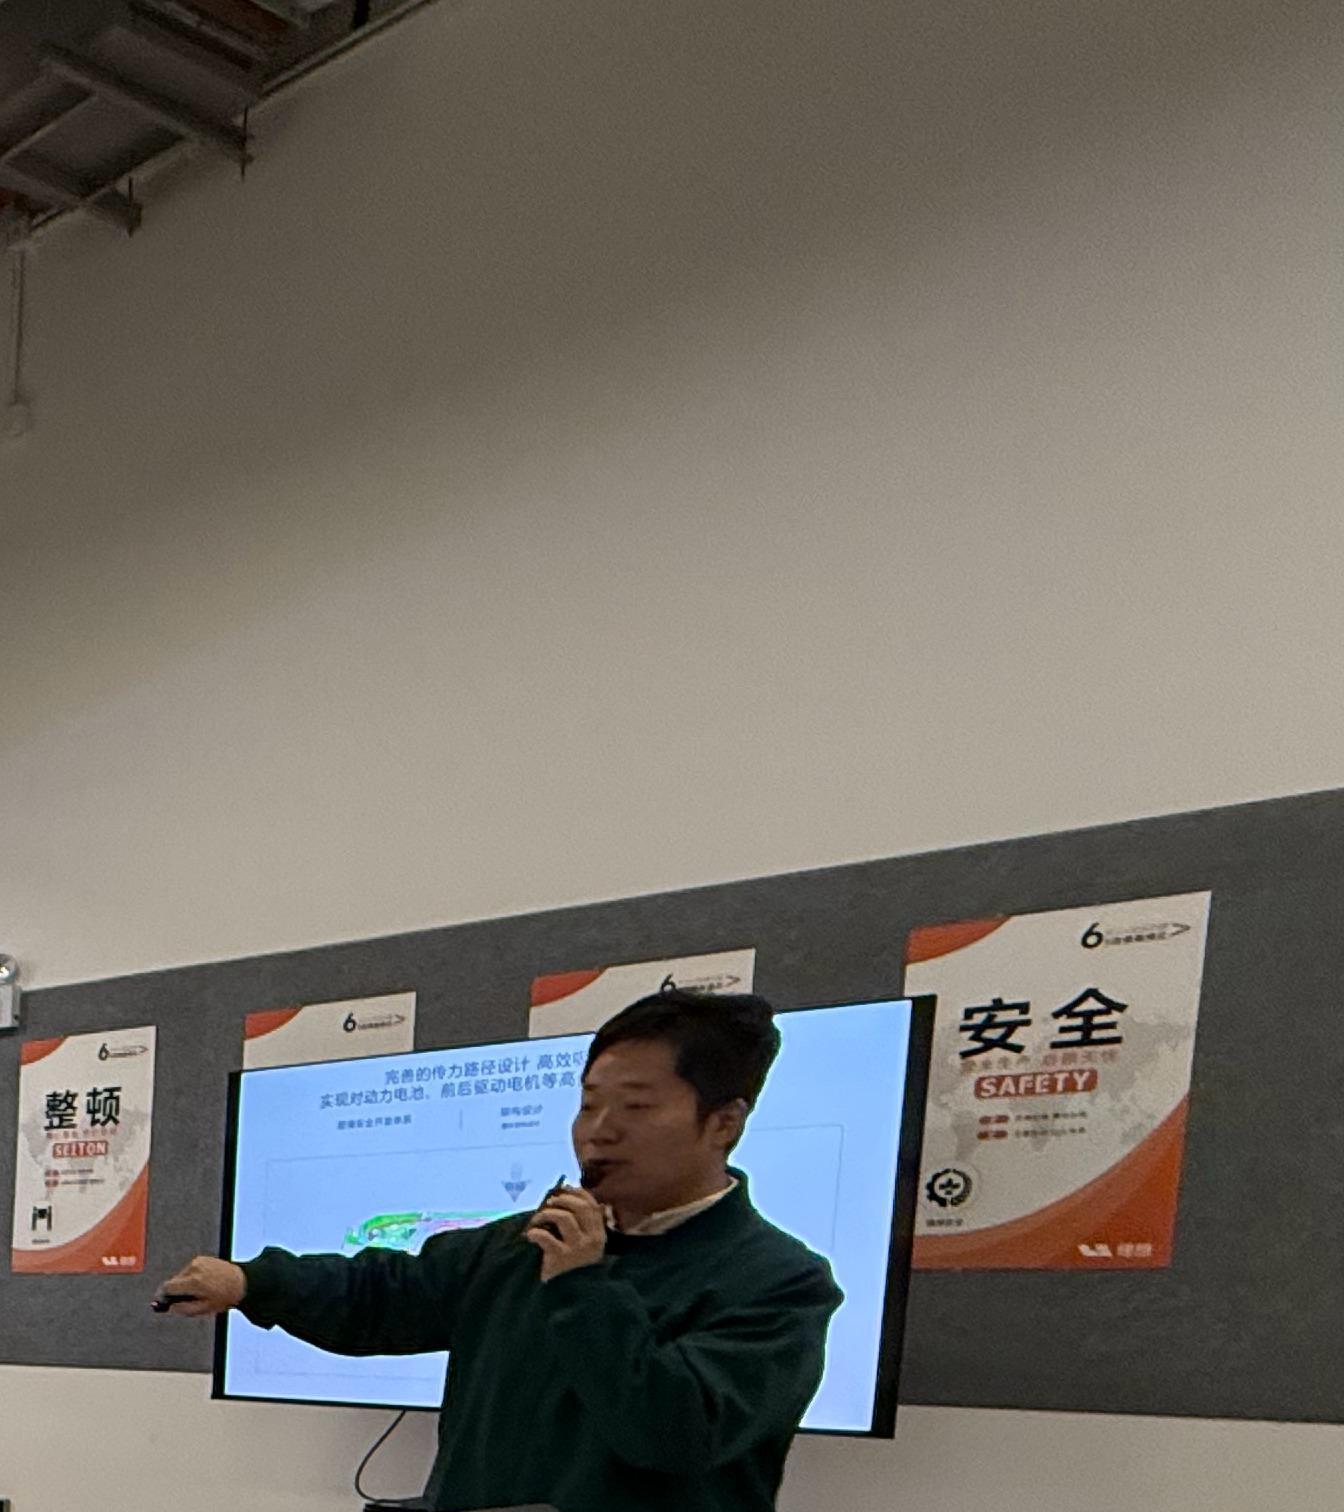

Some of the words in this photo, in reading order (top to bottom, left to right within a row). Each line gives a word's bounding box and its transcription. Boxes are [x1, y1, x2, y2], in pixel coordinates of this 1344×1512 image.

[959, 987, 1128, 1058] 安全
[980, 1071, 1090, 1097] SAFETY
[44, 1087, 122, 1131] 整顿
